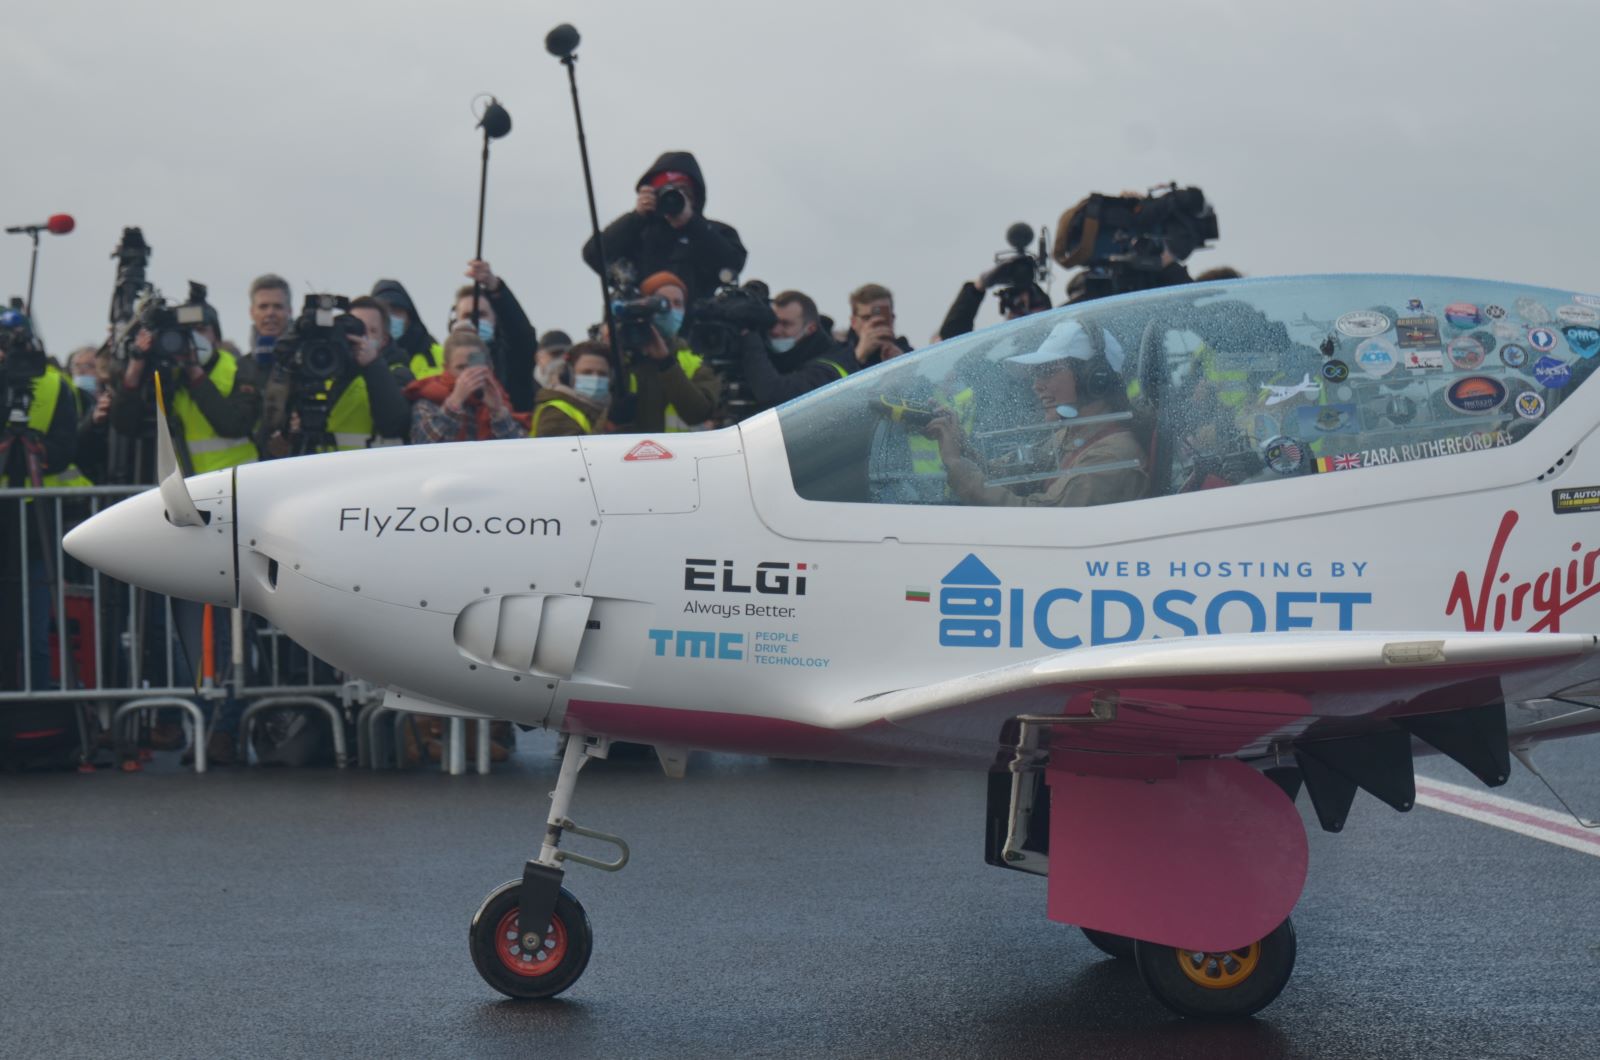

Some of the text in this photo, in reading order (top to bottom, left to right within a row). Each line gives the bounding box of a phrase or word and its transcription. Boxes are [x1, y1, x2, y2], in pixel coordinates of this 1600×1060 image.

[1567, 328, 1599, 341] OMG
[1535, 367, 1569, 377] NASA
[1361, 430, 1513, 467] ZARA RUTHERFORD A+
[1559, 491, 1571, 500] RL
[339, 507, 561, 538] FlyZolo.com
[1086, 561, 1368, 577] WEB HOSTING BY
[683, 600, 796, 619] Always Better.
[1009, 588, 1372, 649] ICDSOFT
[755, 632, 799, 642] PEOPLE
[648, 629, 744, 661] TMC
[754, 643, 788, 654] DRIVE
[754, 655, 830, 668] TECHNOLOGY
